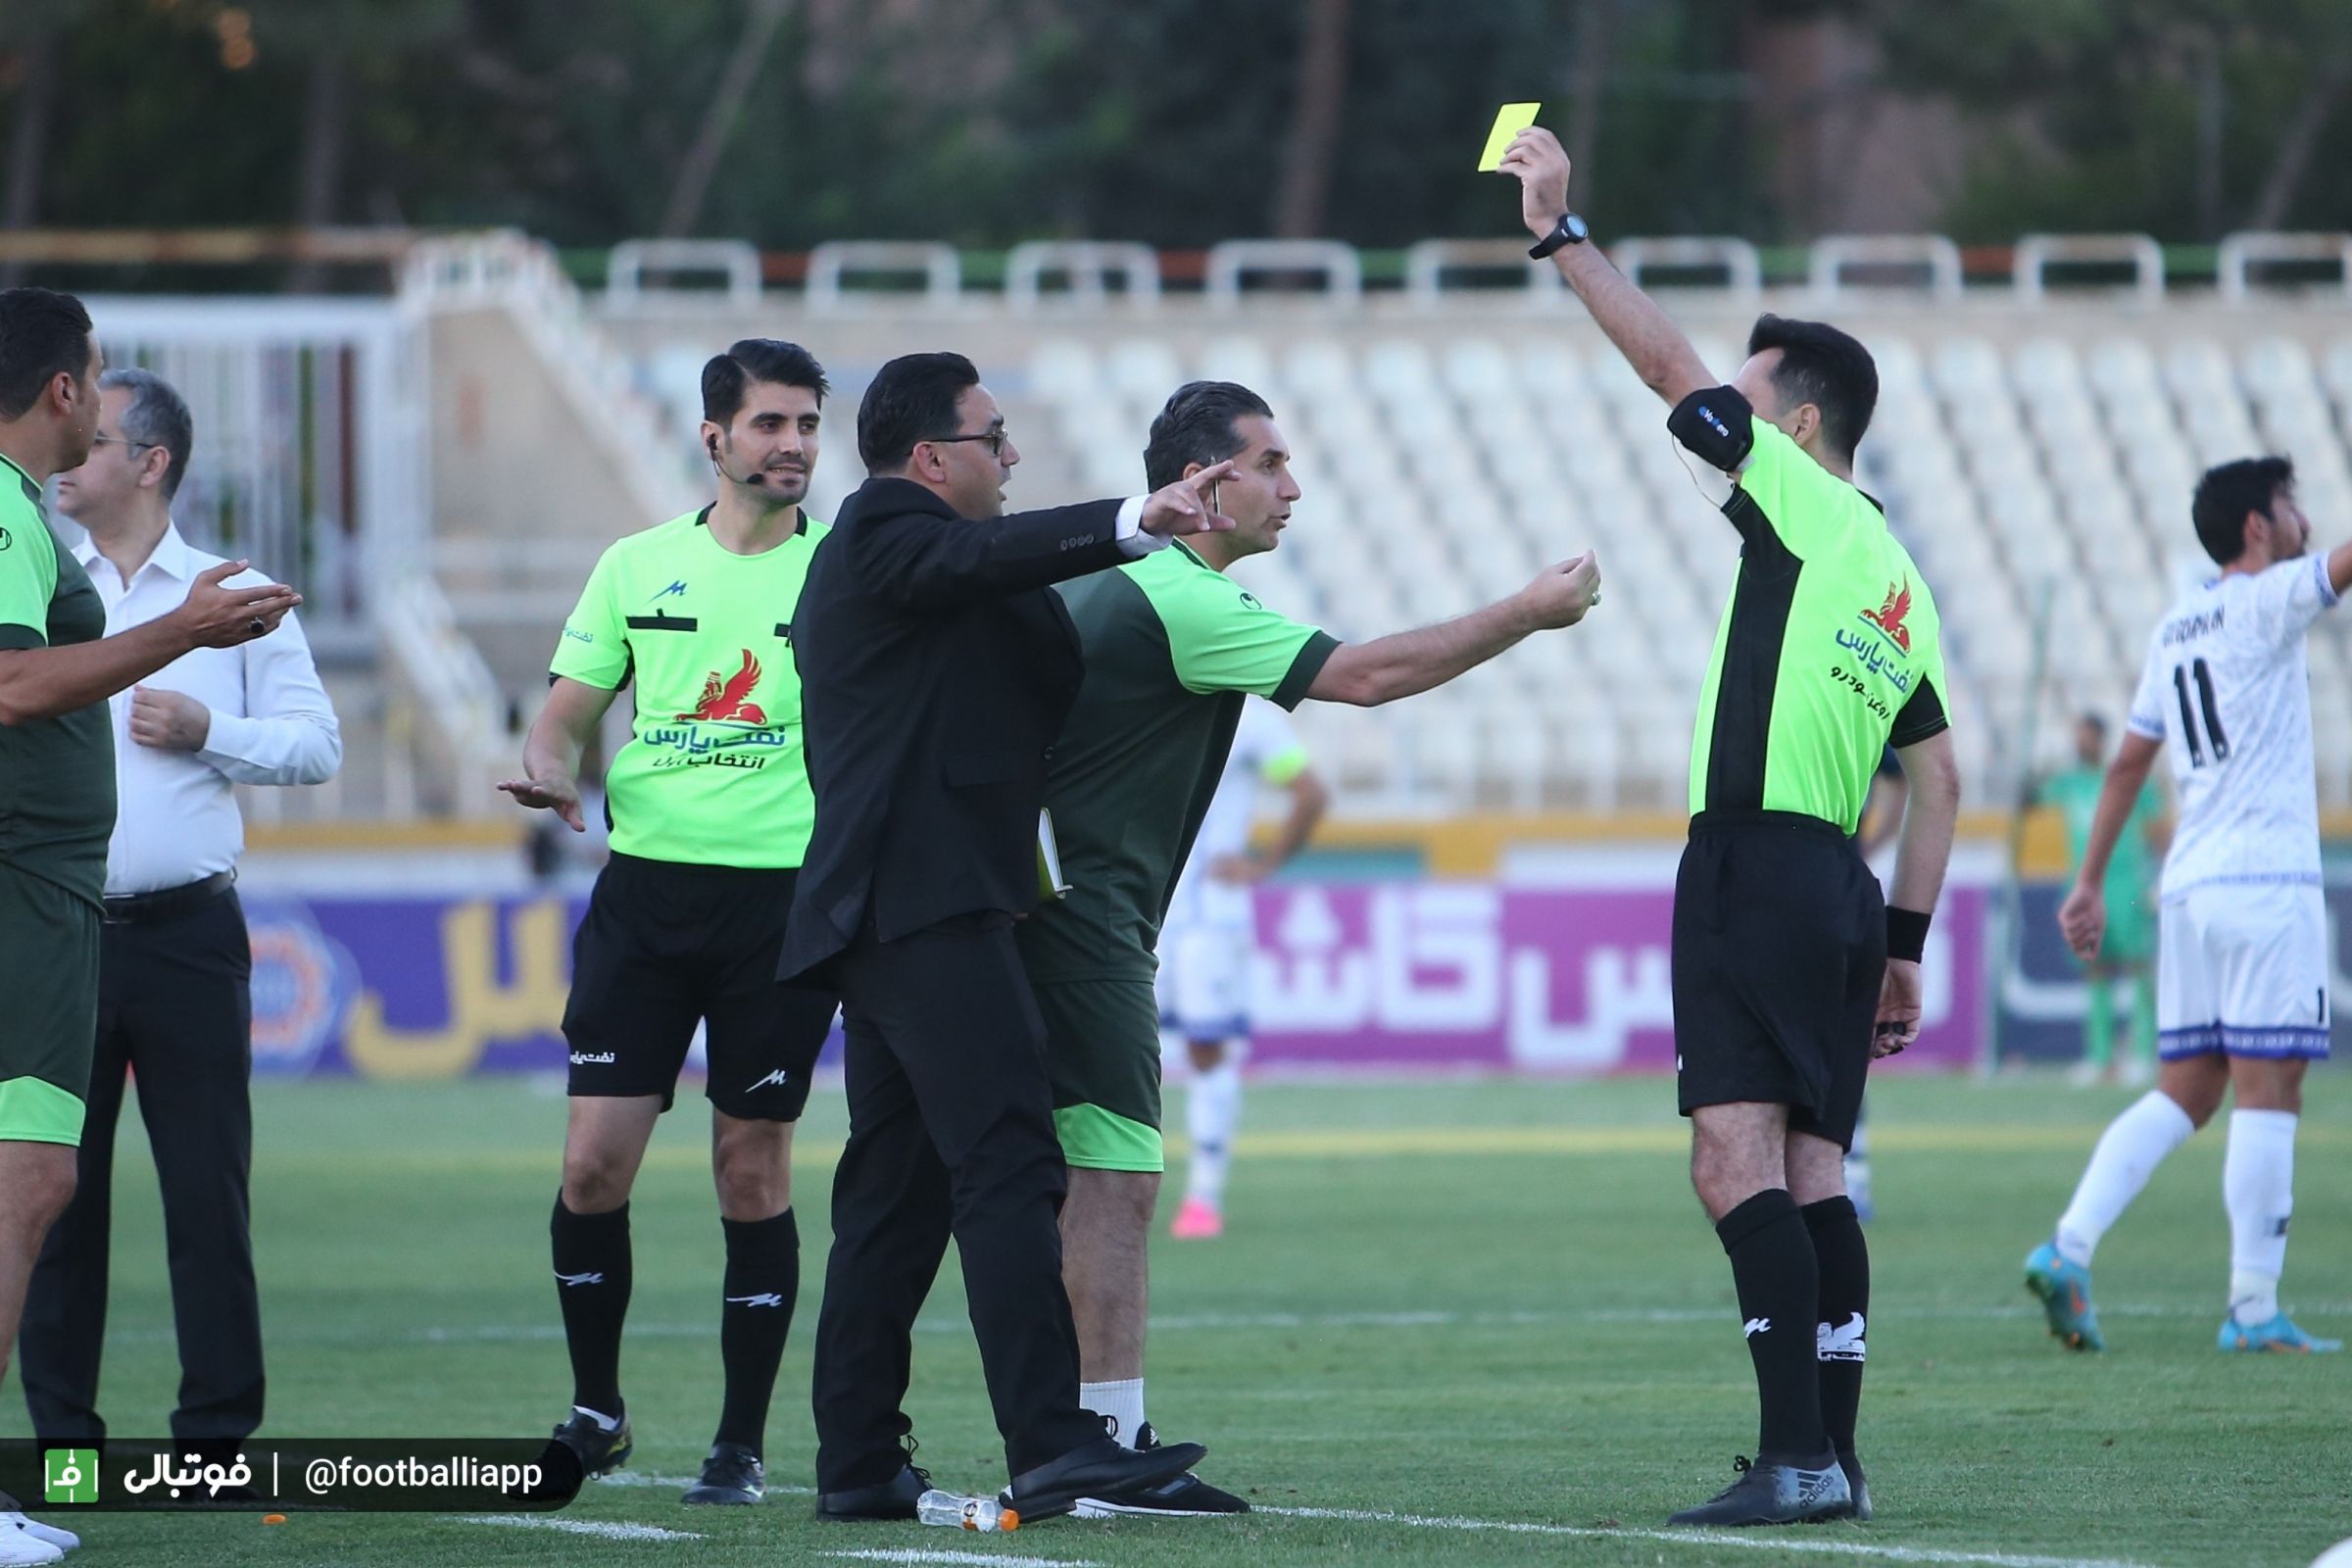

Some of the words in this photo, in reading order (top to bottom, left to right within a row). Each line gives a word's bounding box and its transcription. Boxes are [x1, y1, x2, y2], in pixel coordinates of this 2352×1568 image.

[1836, 628, 1885, 675] پارس
[2174, 658, 2230, 770] 11
[644, 725, 710, 755] پارس
[687, 752, 765, 769] انتخاب
[1799, 1474, 1834, 1509] adidas
